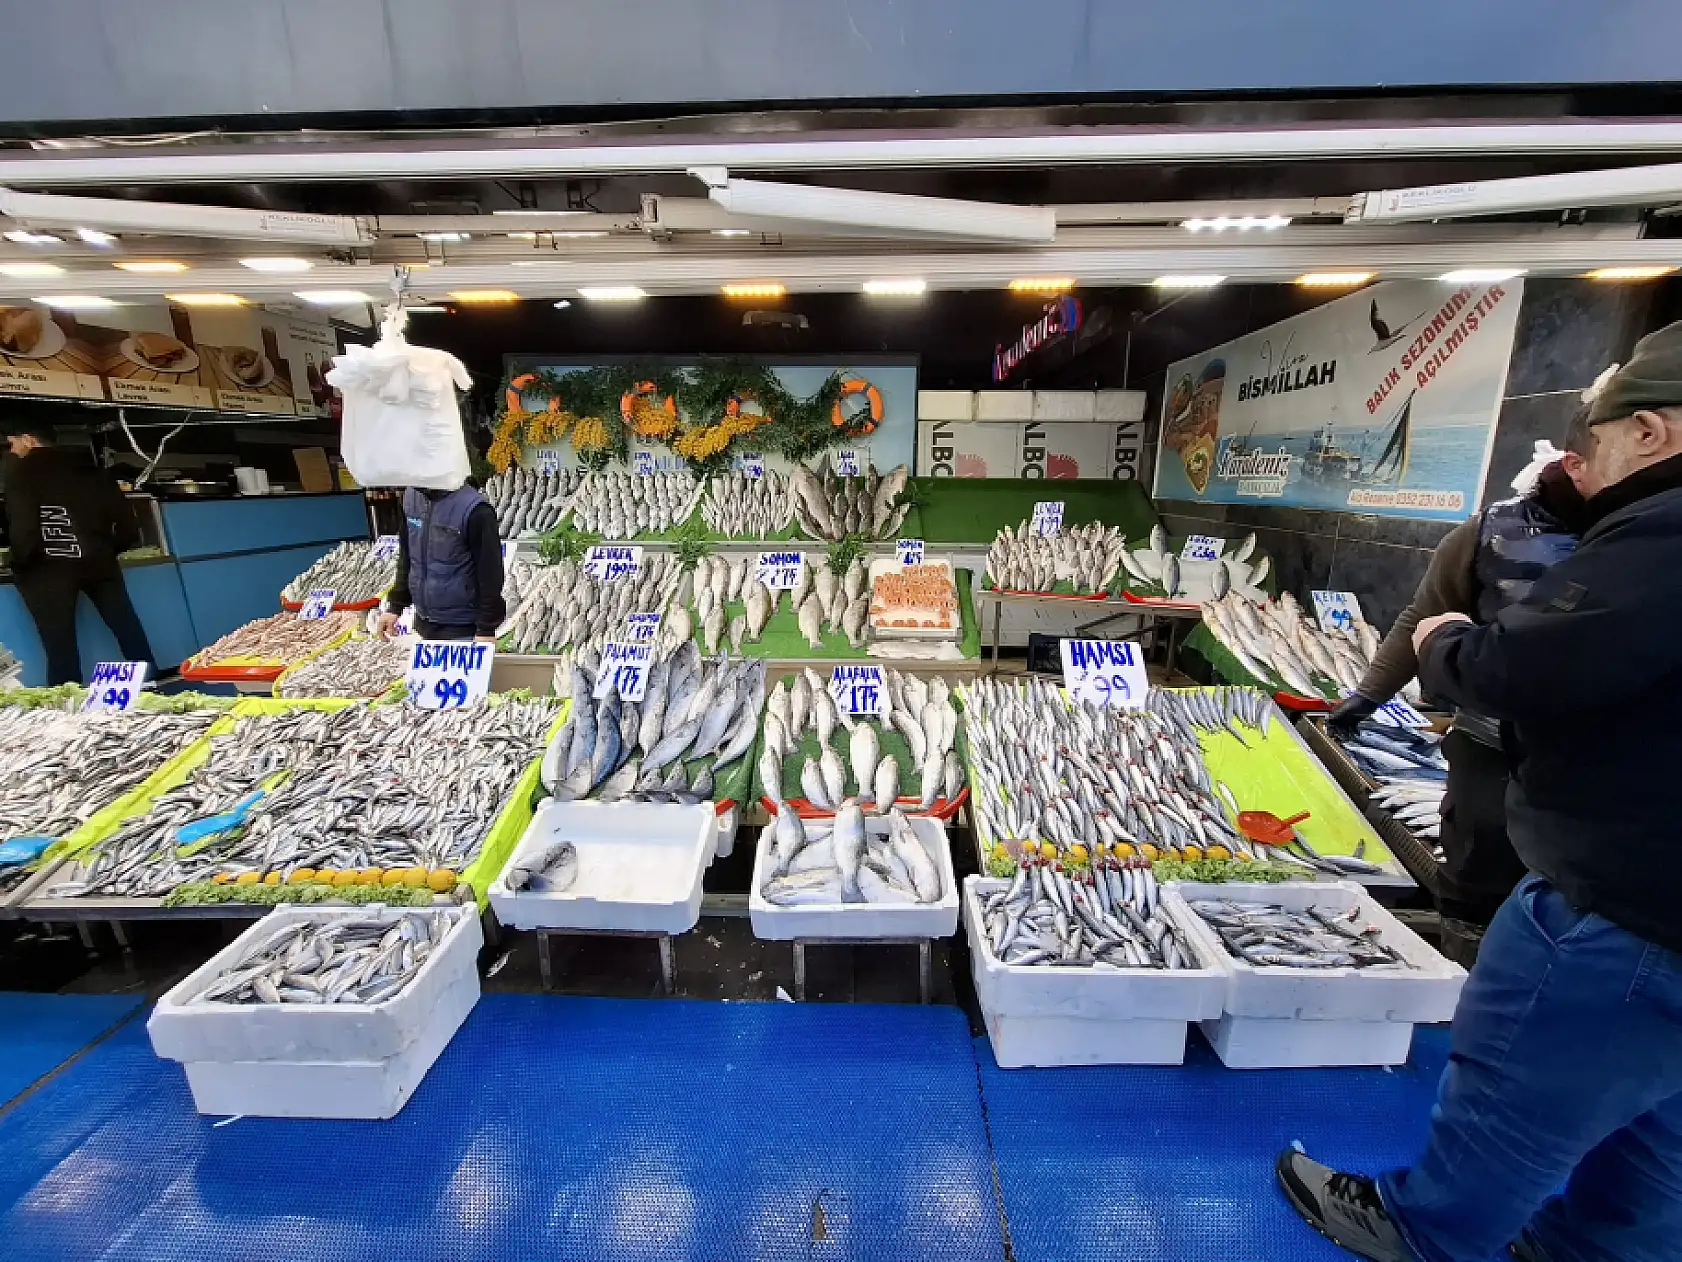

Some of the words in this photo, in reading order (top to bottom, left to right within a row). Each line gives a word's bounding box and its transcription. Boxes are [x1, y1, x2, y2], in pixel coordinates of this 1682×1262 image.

[1366, 368, 1401, 414] BALIK
[1401, 284, 1479, 370] SEZONUM
[1238, 360, 1336, 401] BİSMİLLAH
[103, 687, 129, 711] 99
[435, 679, 467, 708] 99
